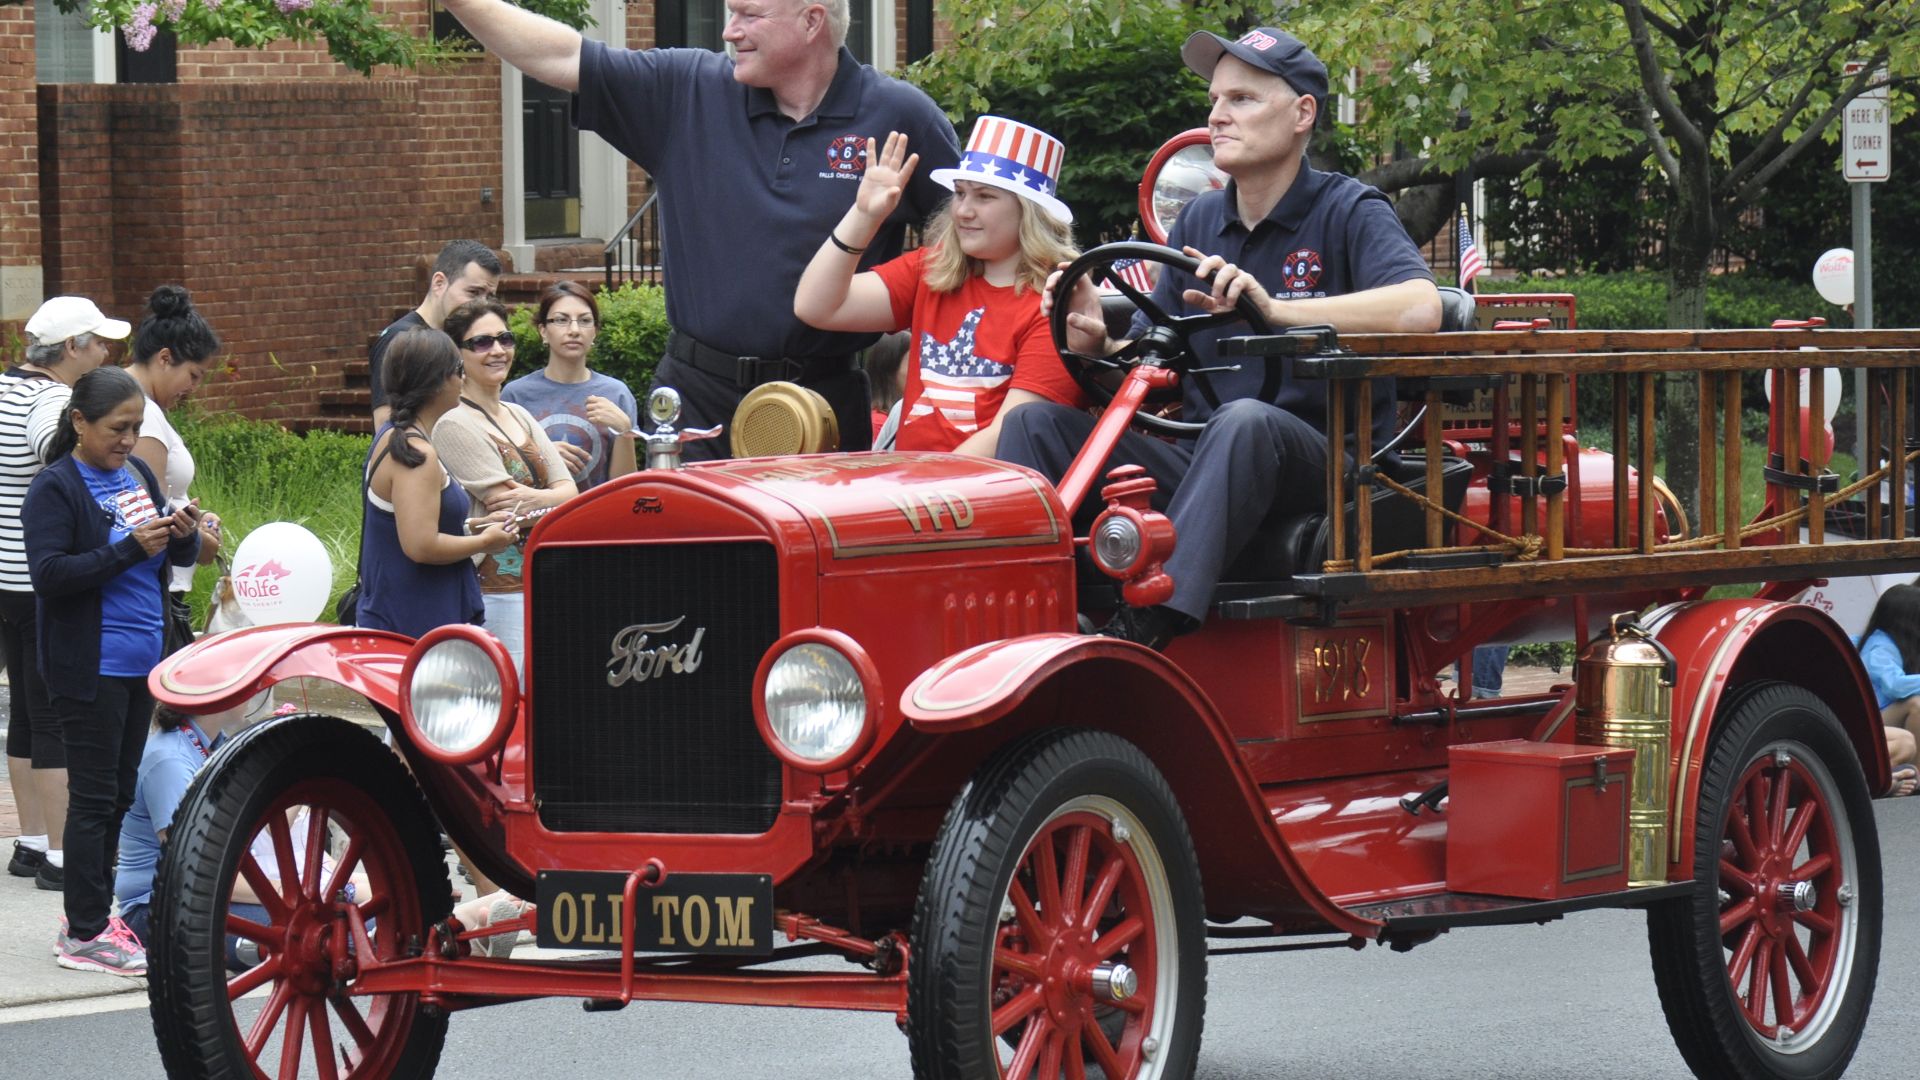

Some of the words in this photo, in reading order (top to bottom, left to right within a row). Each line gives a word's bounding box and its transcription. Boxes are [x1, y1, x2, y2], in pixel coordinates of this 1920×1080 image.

[1851, 109, 1871, 123] HERE
[1874, 109, 1883, 123] TO
[1852, 135, 1882, 150] CORNER
[843, 146, 852, 158] 6
[1297, 262, 1305, 275] 6
[632, 496, 664, 514] Ford
[885, 489, 974, 533] VFD
[235, 579, 280, 598] Wolfe
[606, 615, 706, 688] Ford
[1314, 638, 1371, 703] 1918
[652, 894, 755, 947] TOM
